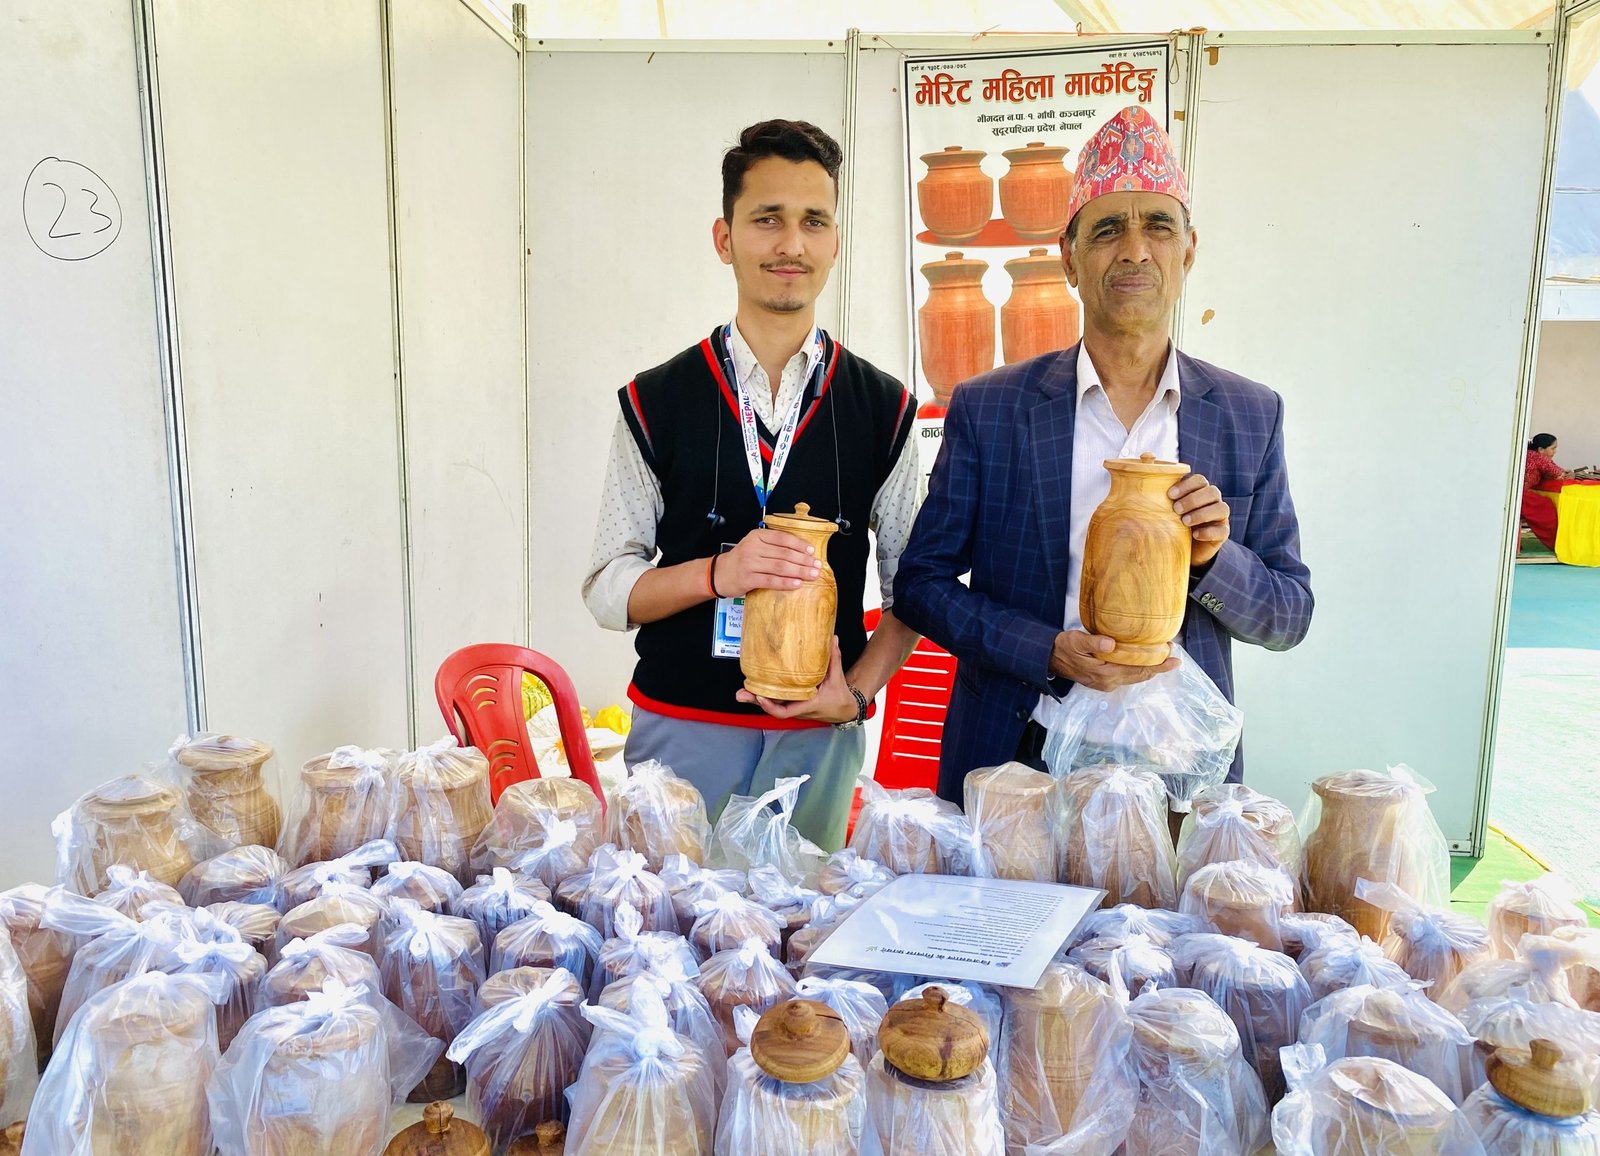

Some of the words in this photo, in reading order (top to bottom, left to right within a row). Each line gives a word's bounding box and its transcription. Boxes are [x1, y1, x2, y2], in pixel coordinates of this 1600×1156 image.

[915, 72, 973, 105] मेरिट
[982, 68, 1056, 102] महिला
[1064, 61, 1158, 102] मार्केटिङ्ग
[991, 124, 1035, 136] सुदूरपश्चिम
[1036, 123, 1056, 133] प्रदेश
[1059, 121, 1082, 131] नेपाल
[42, 182, 112, 239] 23
